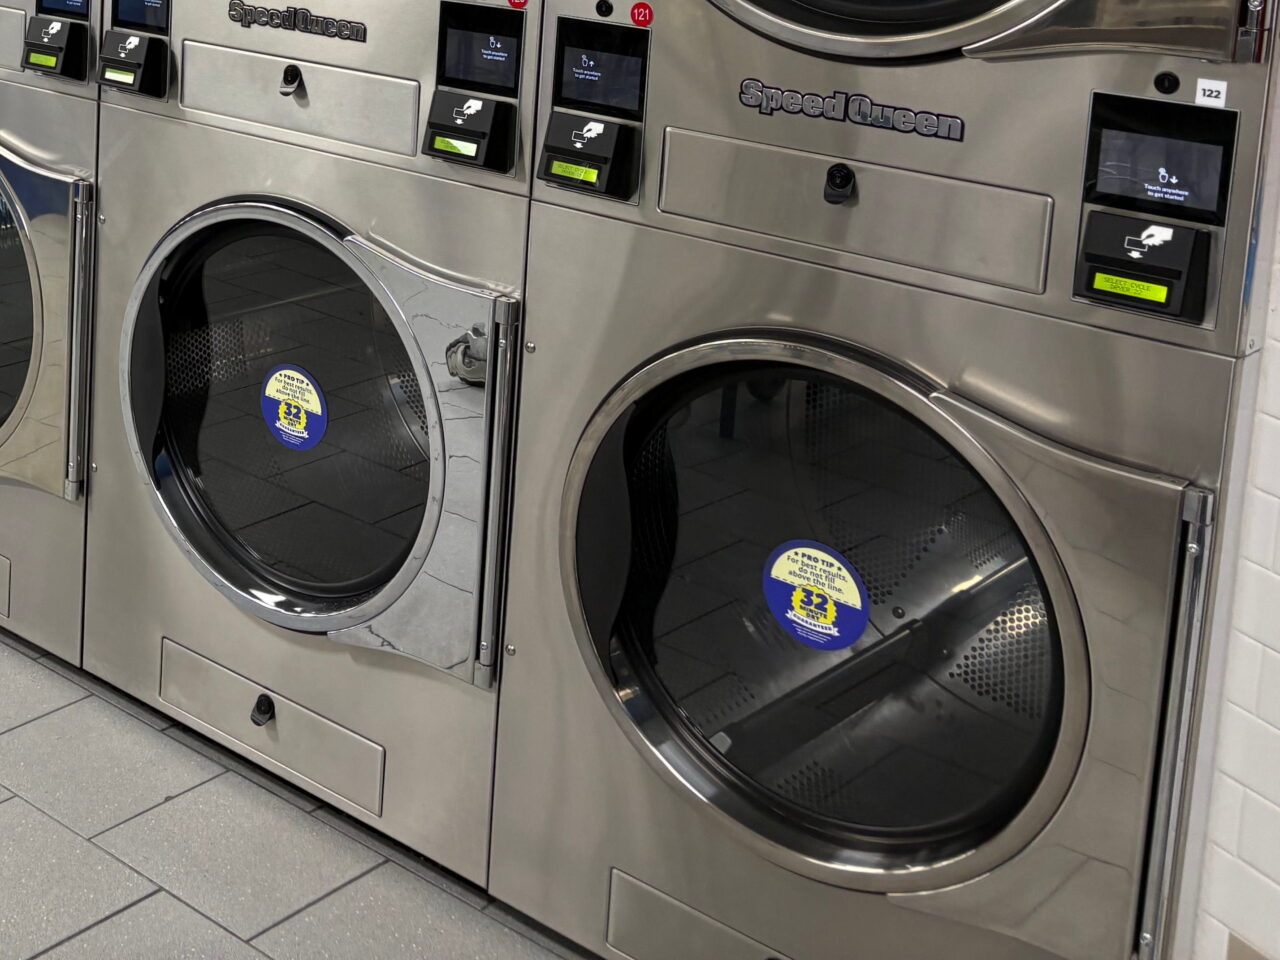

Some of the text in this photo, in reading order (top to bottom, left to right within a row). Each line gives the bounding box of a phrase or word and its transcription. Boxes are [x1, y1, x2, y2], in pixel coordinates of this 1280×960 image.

[229, 0, 366, 43] Speed Queen
[634, 9, 649, 20] 121
[1202, 89, 1221, 98] 122
[740, 78, 964, 142] Speed Queen
[1104, 277, 1126, 287] SELECT
[284, 403, 301, 420] 32
[787, 555, 848, 582] For best results,
[802, 553, 835, 568] PRO TIP
[789, 570, 844, 594] above the line.
[810, 571, 822, 580] not
[825, 575, 835, 584] fill
[800, 587, 828, 613] 32
[800, 605, 827, 619] MINUTE
